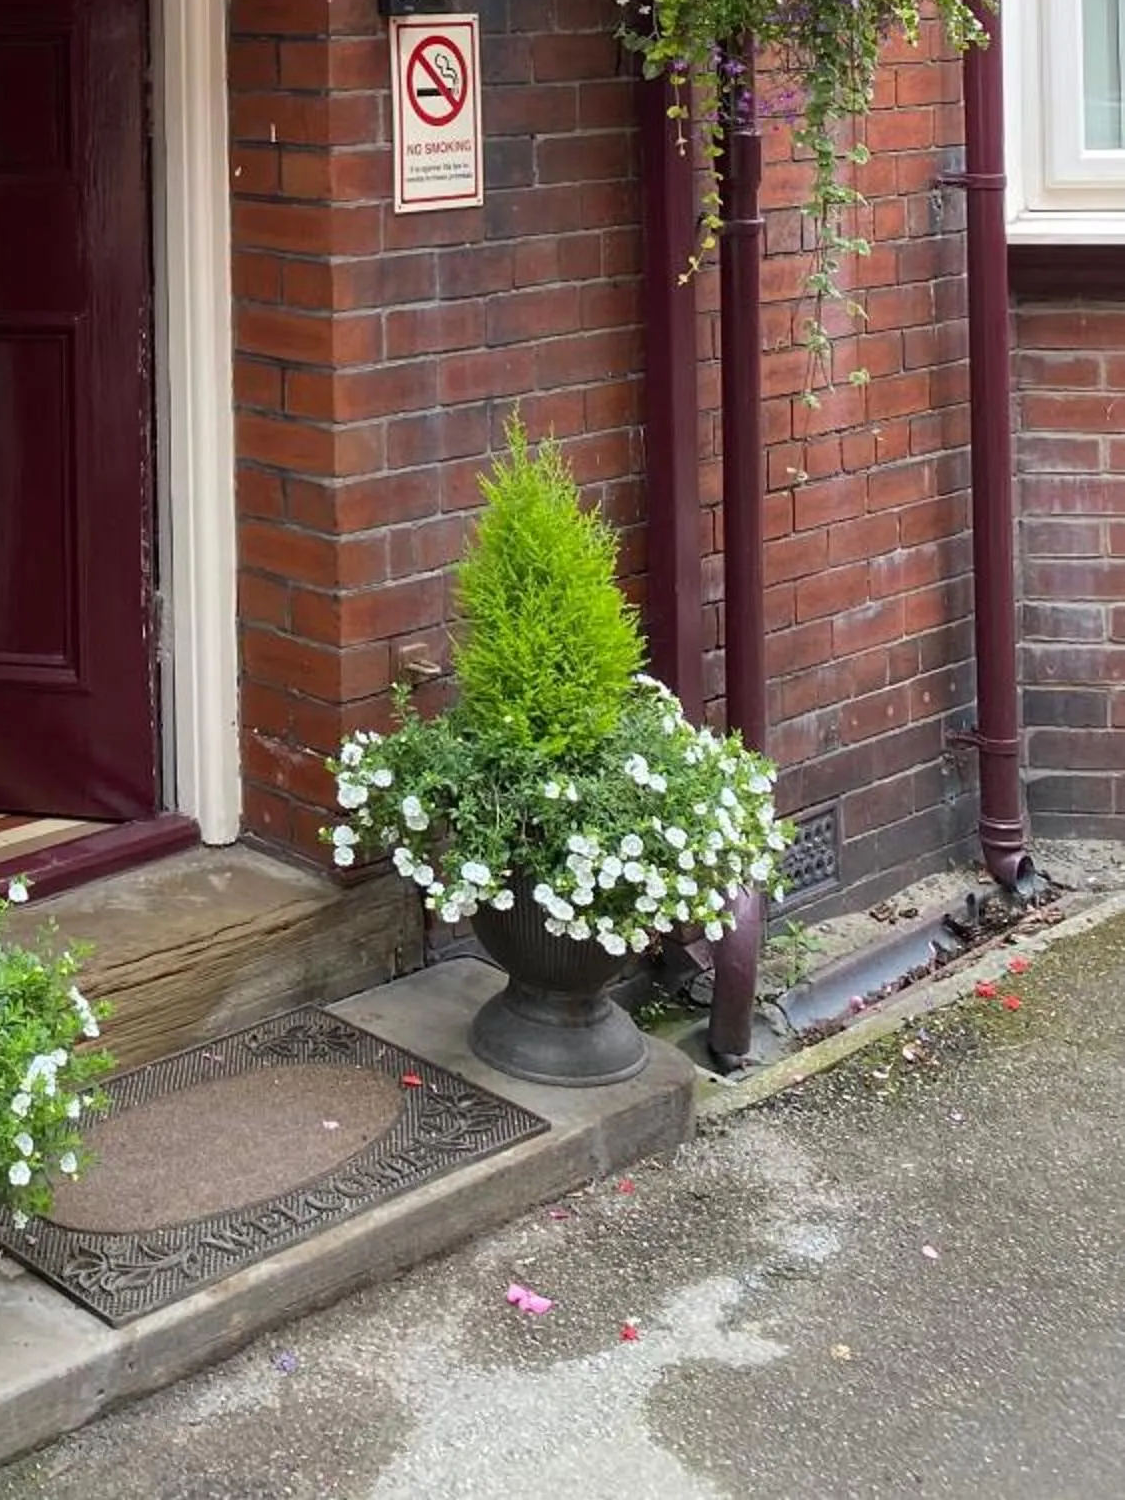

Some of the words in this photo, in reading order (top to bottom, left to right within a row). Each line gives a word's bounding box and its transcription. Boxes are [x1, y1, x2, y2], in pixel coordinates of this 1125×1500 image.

[406, 143, 422, 155] NO
[424, 139, 472, 155] SMOKING
[199, 1145, 434, 1255] WELCOME
